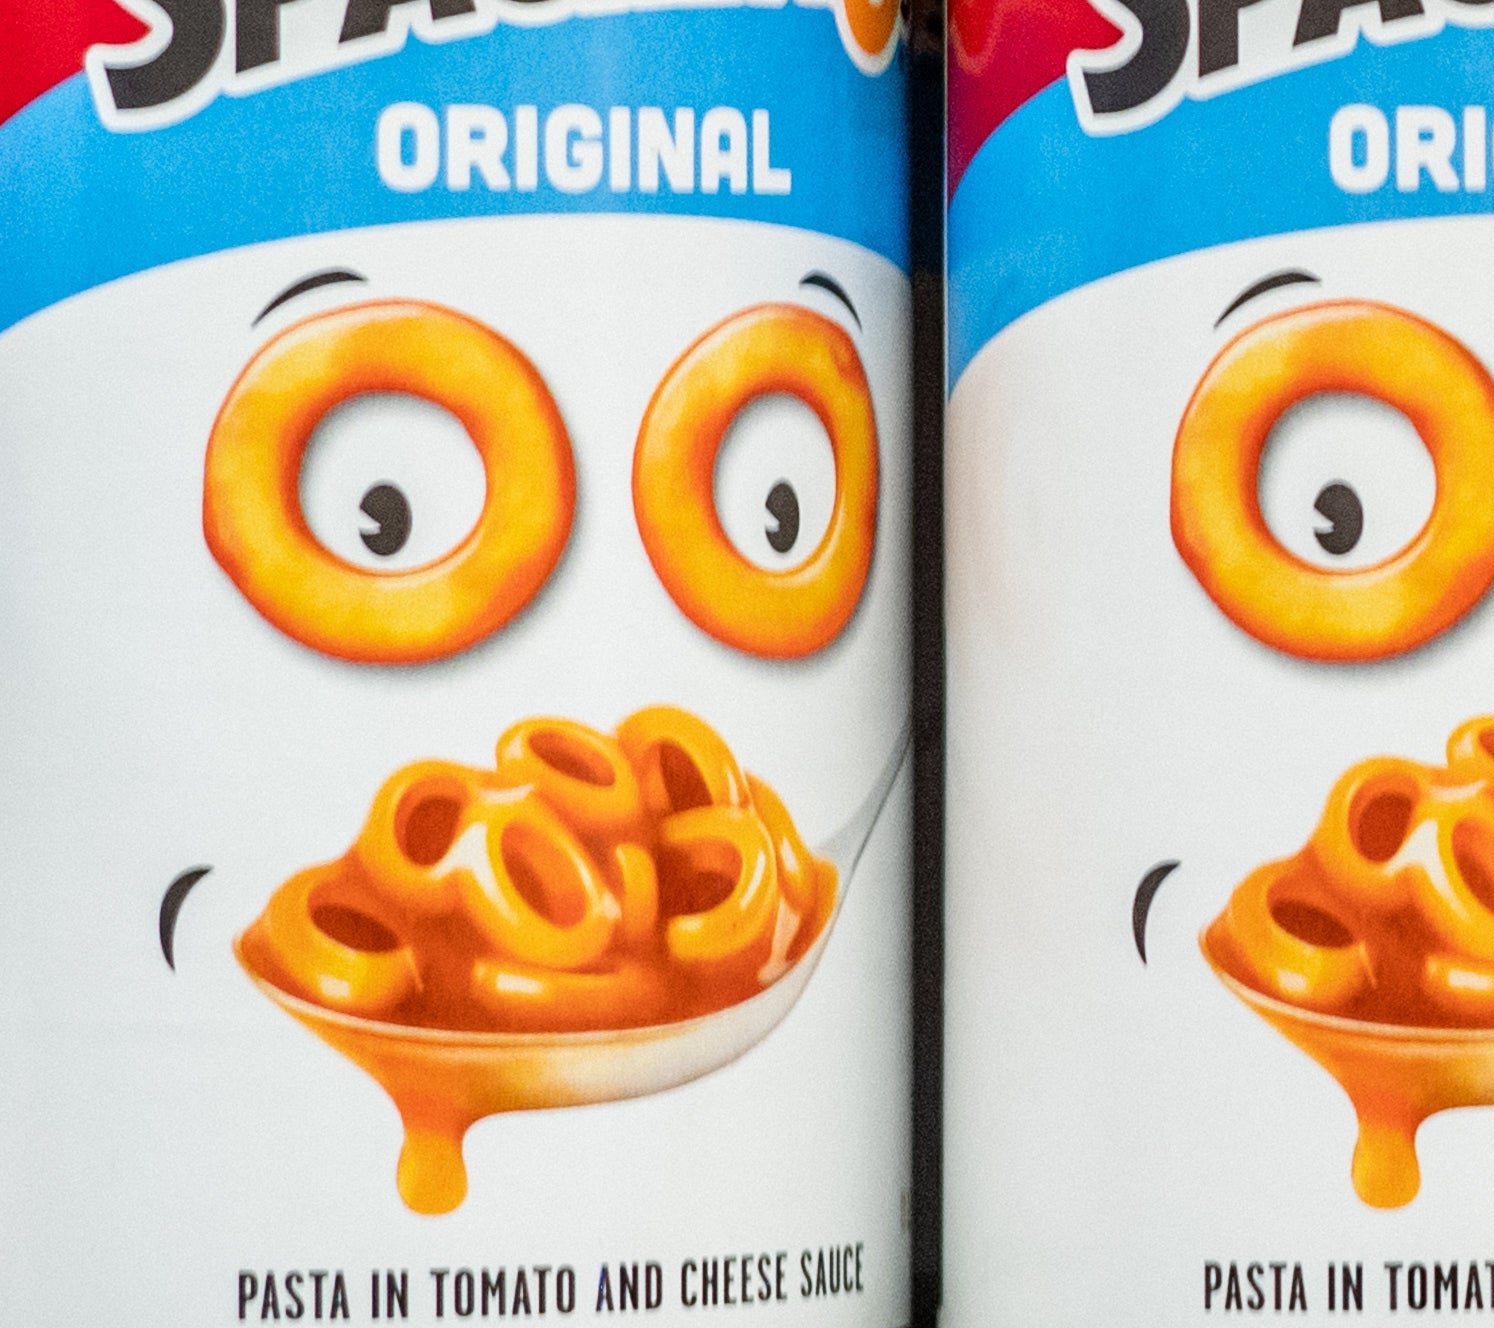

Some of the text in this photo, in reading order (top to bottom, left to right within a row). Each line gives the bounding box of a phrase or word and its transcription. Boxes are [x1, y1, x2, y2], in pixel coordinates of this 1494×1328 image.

[377, 102, 791, 193] ORIGINAL
[238, 1242, 864, 1320] PASTA IN TOMATO AND CHEESE SAUCE
